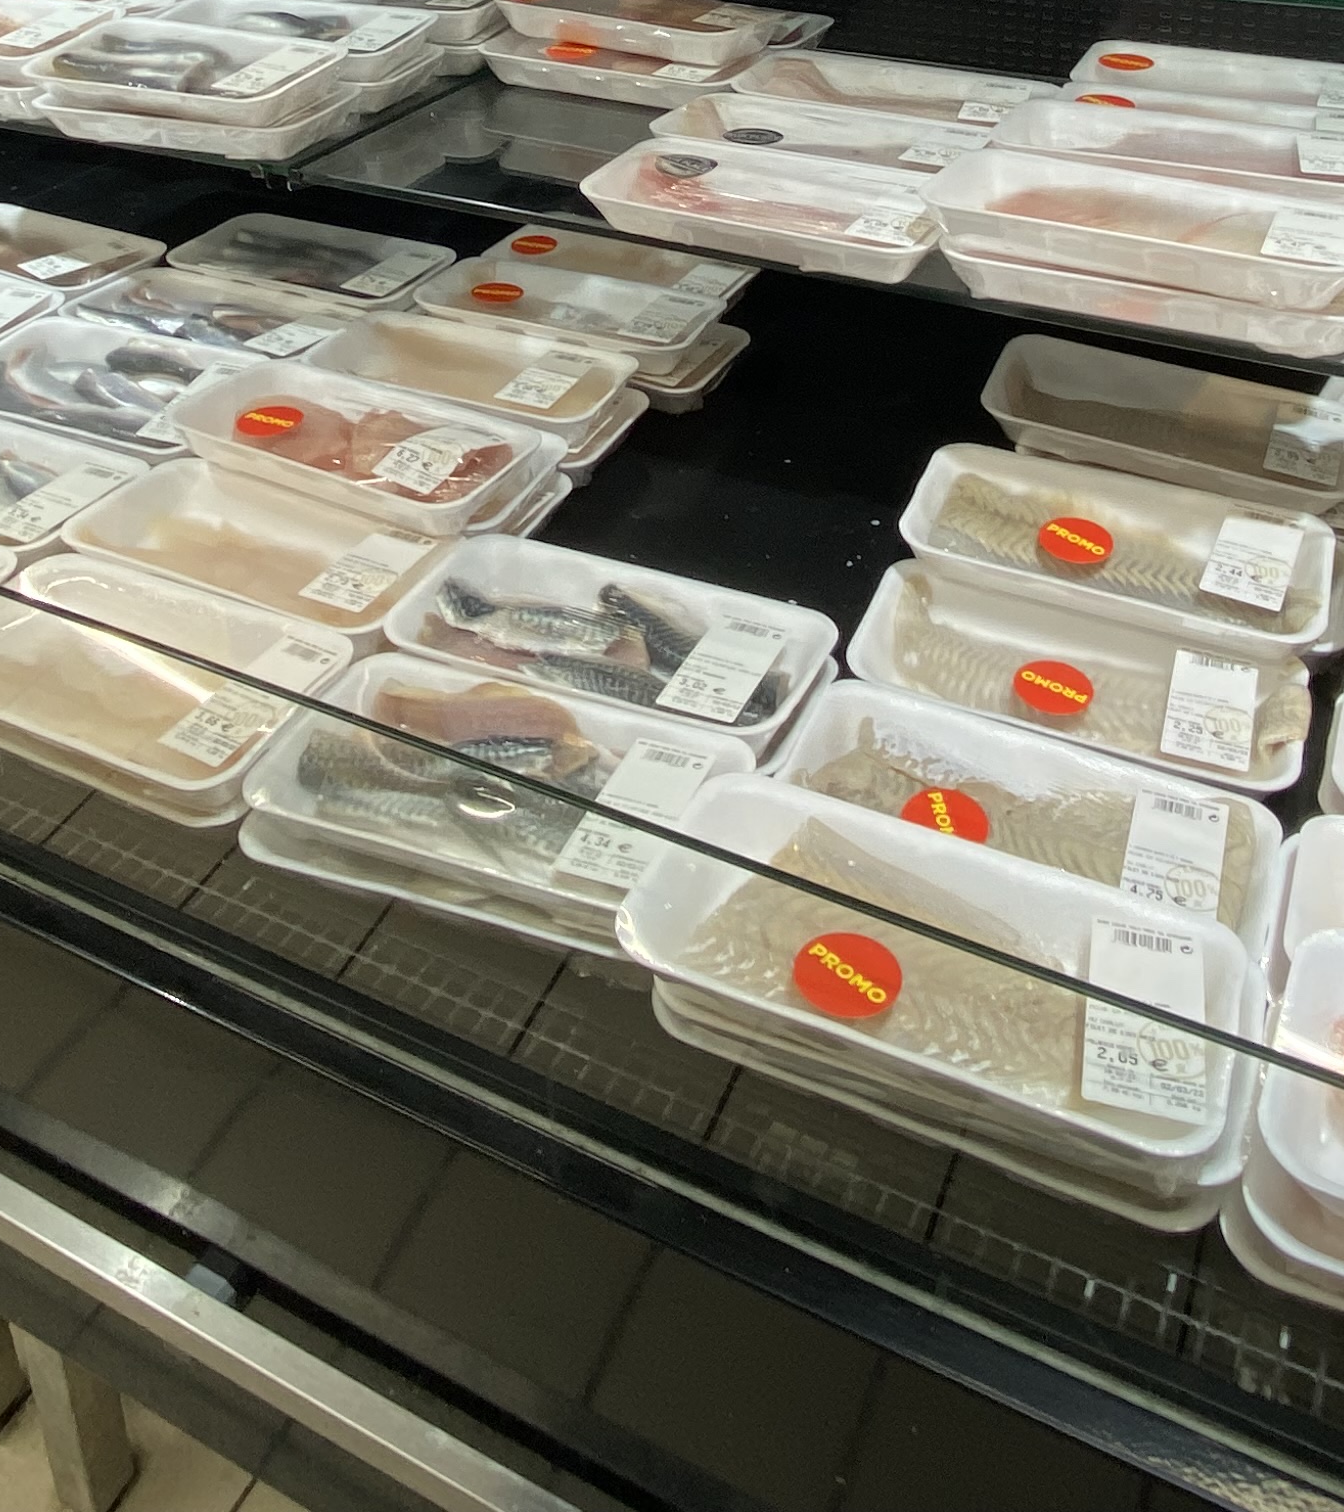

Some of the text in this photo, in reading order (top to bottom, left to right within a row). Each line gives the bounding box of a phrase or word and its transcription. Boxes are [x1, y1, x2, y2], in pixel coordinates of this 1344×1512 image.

[244, 412, 294, 428] PROMO
[1046, 523, 1106, 557] PROMO
[1021, 670, 1088, 705] PROMO
[1130, 884, 1163, 901] 4.75
[809, 944, 887, 1005] PROMO
